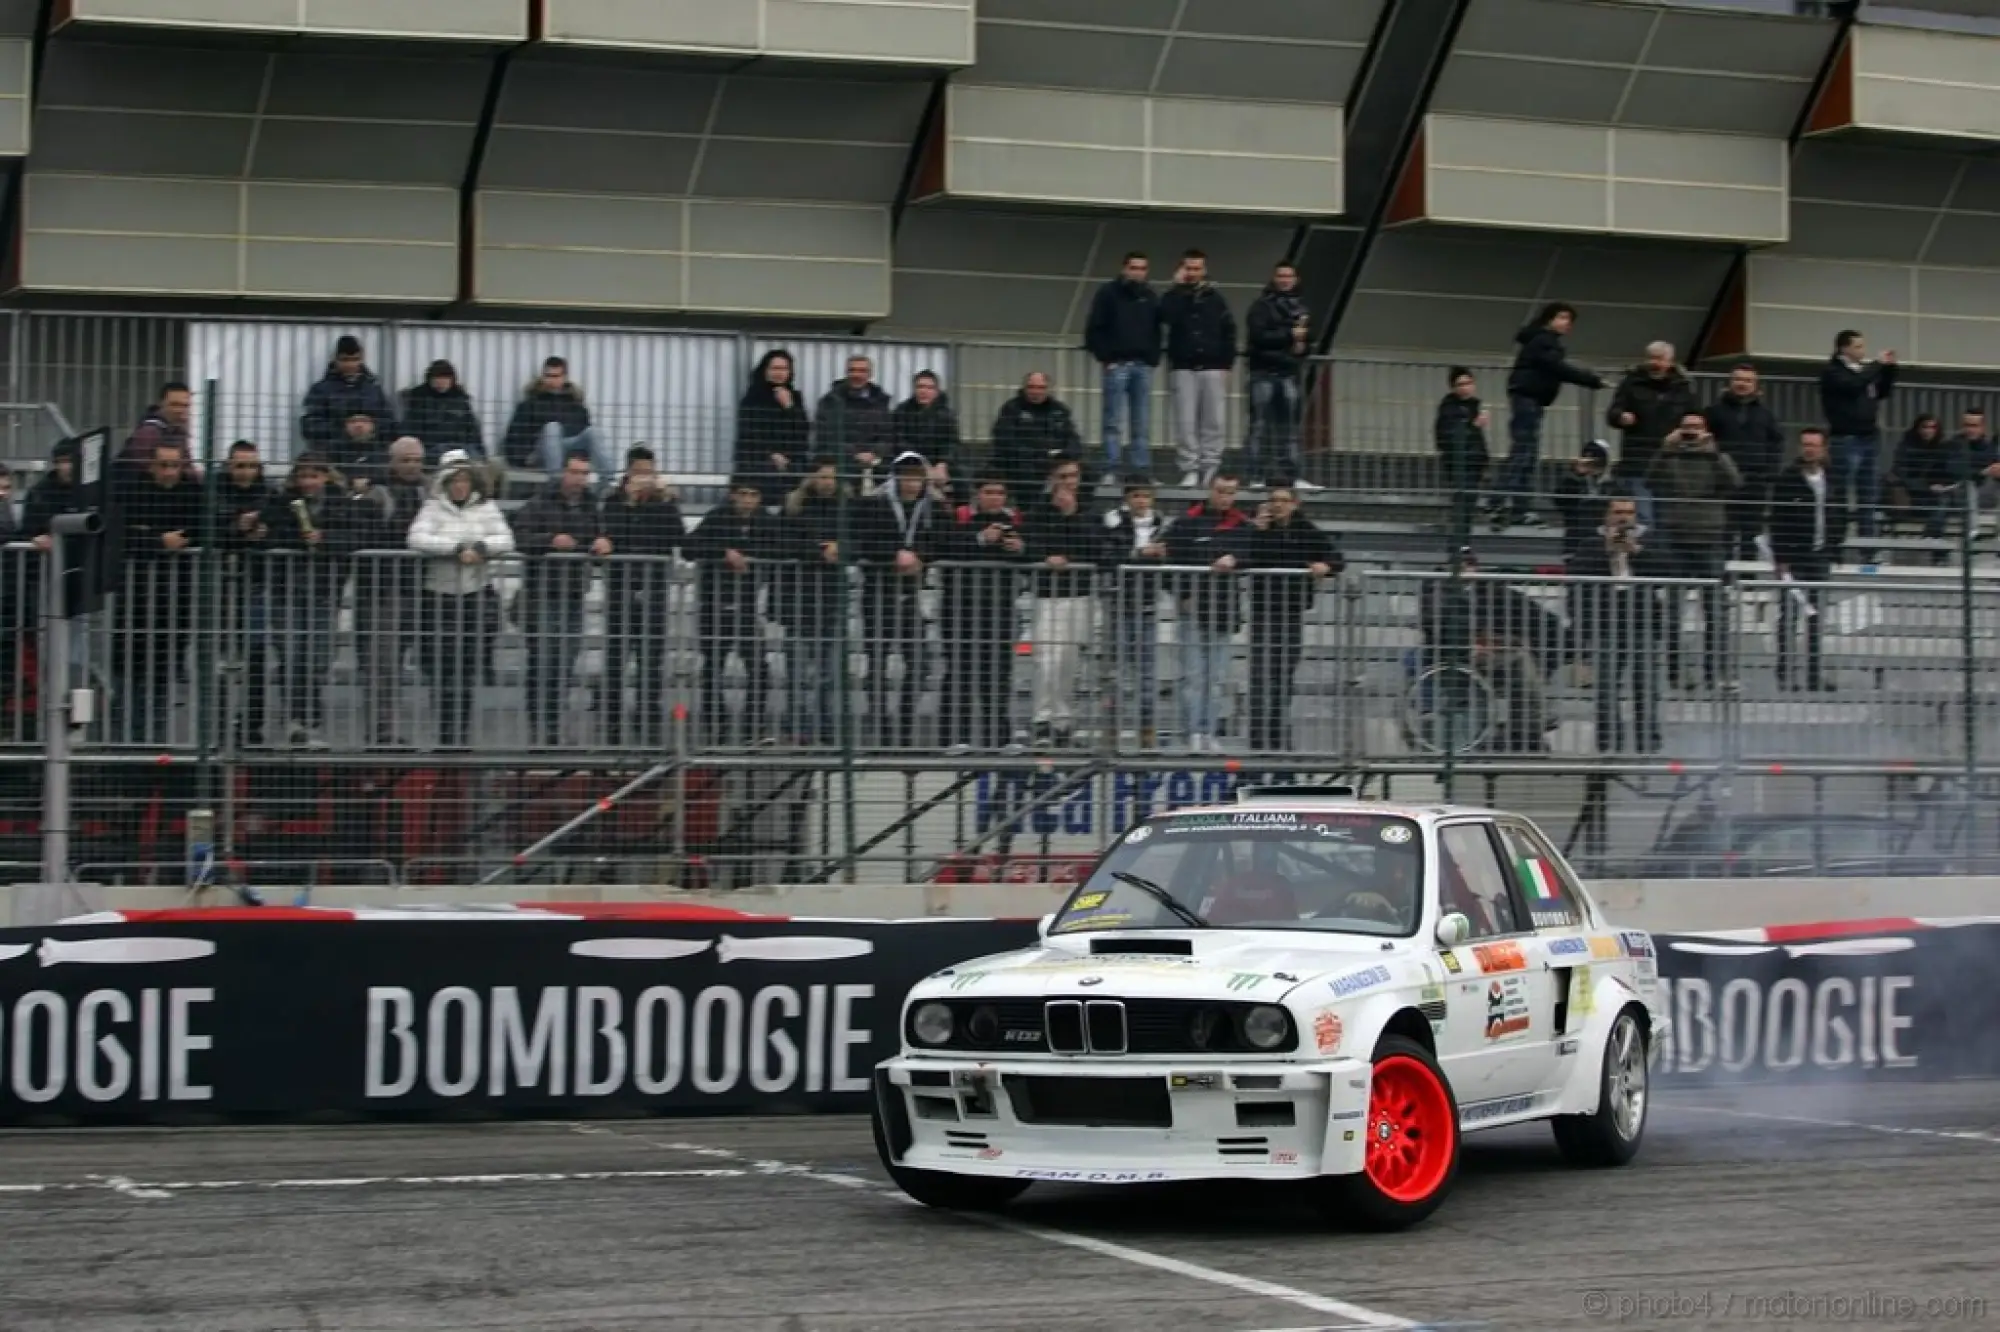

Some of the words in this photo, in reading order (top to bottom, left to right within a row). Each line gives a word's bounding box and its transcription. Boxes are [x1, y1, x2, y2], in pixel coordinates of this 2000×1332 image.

[1231, 812, 1297, 824] ITALIANA
[0, 987, 214, 1103] OGIE
[364, 983, 875, 1099] BOMBOOGIE
[1660, 975, 1919, 1075] BOOGIE
[1015, 1168, 1082, 1180] TEAM
